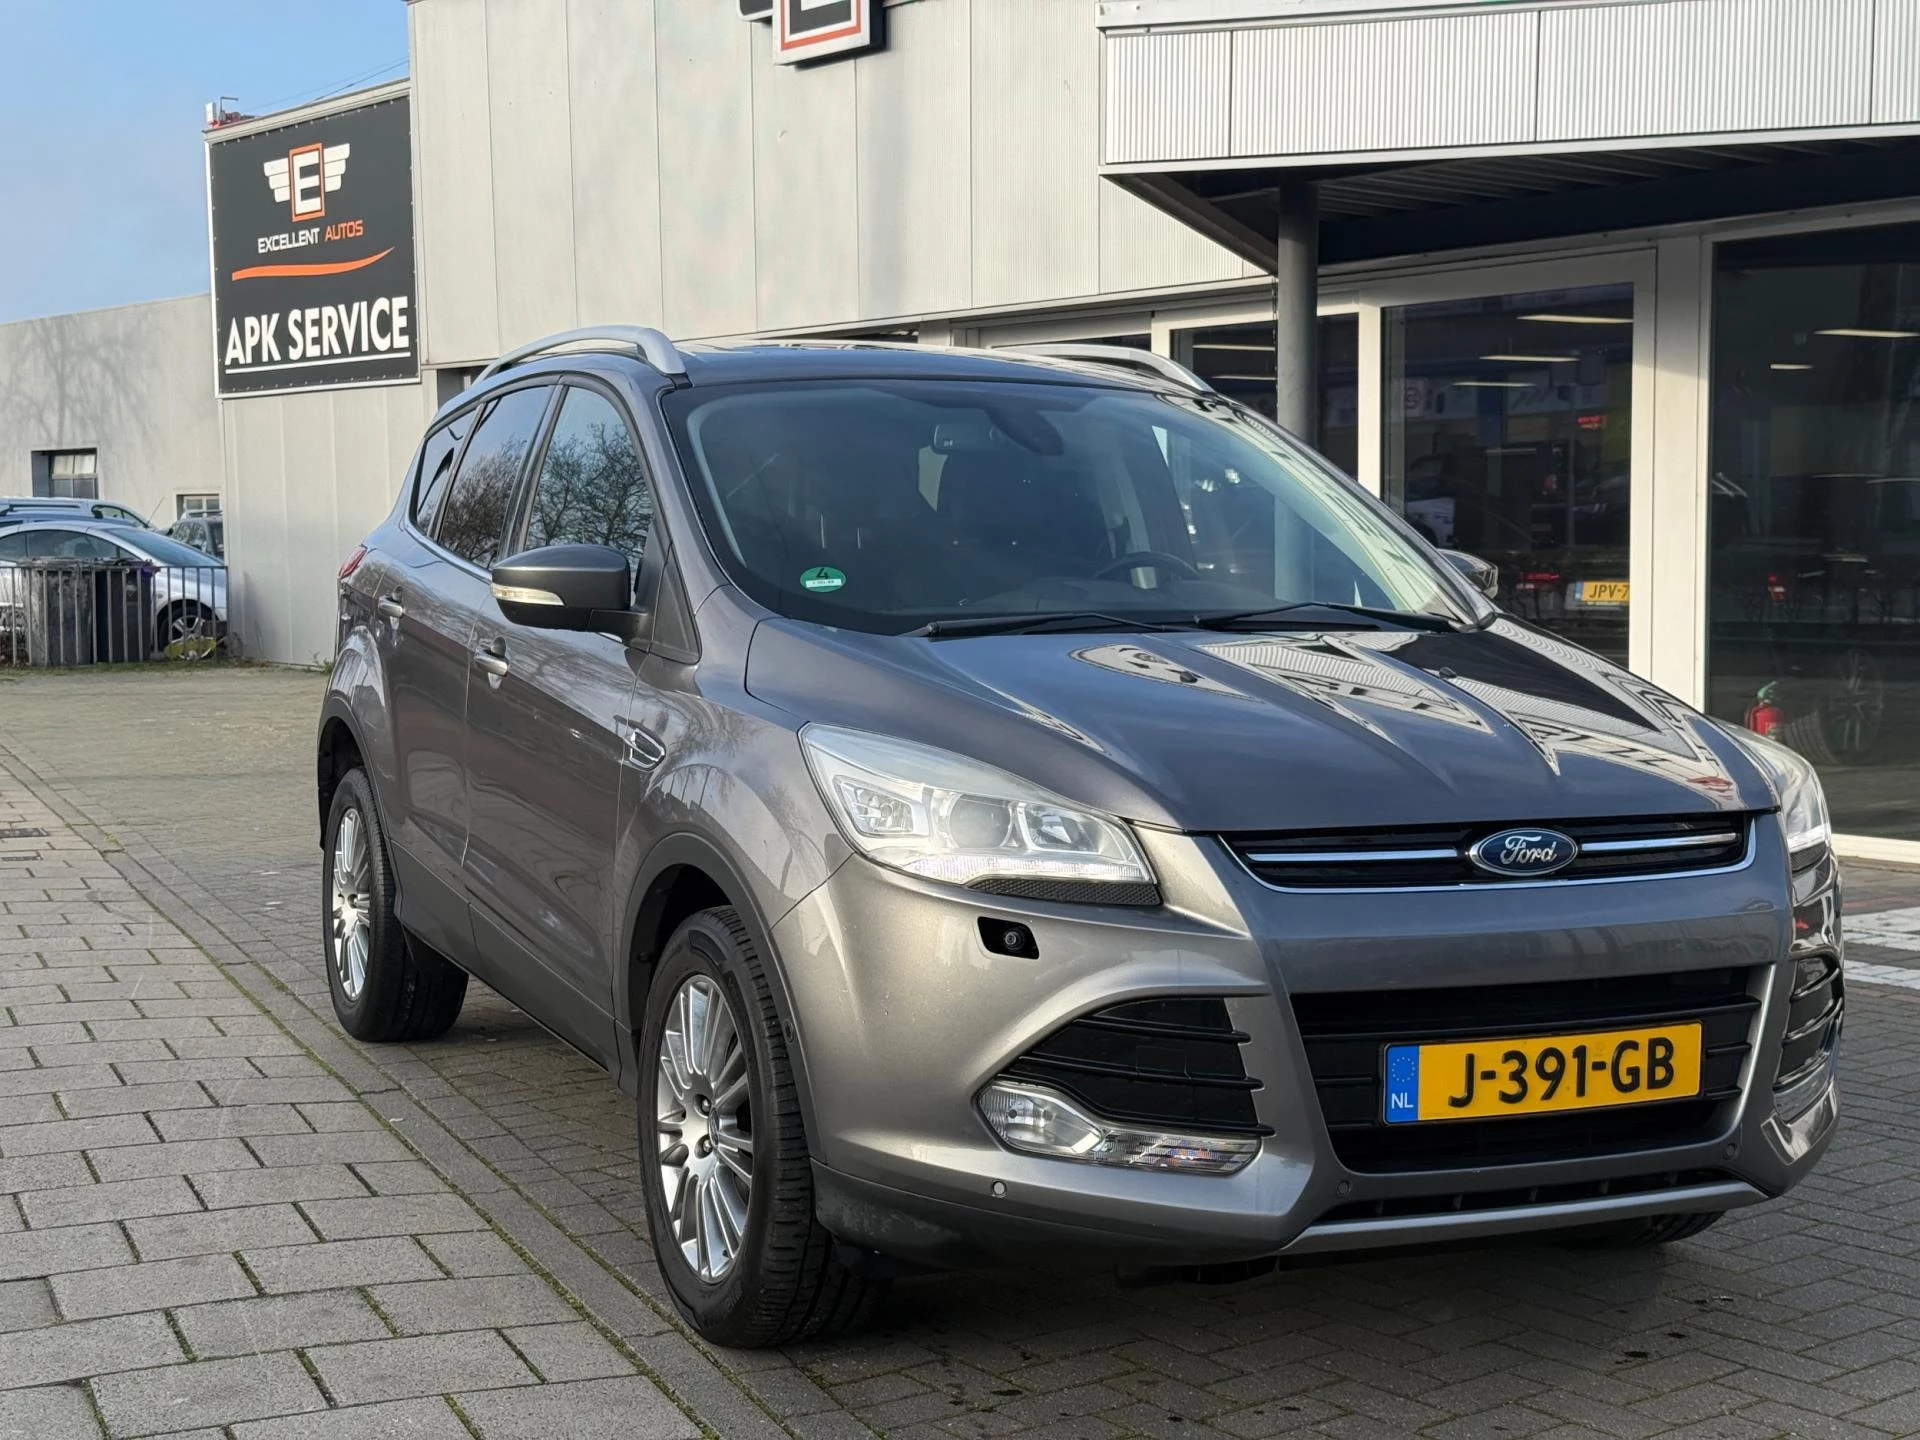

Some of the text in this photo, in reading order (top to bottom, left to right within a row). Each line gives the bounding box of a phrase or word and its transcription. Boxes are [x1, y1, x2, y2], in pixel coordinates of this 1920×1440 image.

[257, 220, 363, 254] EXCELLENT AUTOS
[224, 295, 409, 366] APK SERVICE
[1500, 835, 1558, 865] Ford
[1447, 1036, 1675, 1109] J-391-GB
[1391, 1092, 1414, 1110] NL
